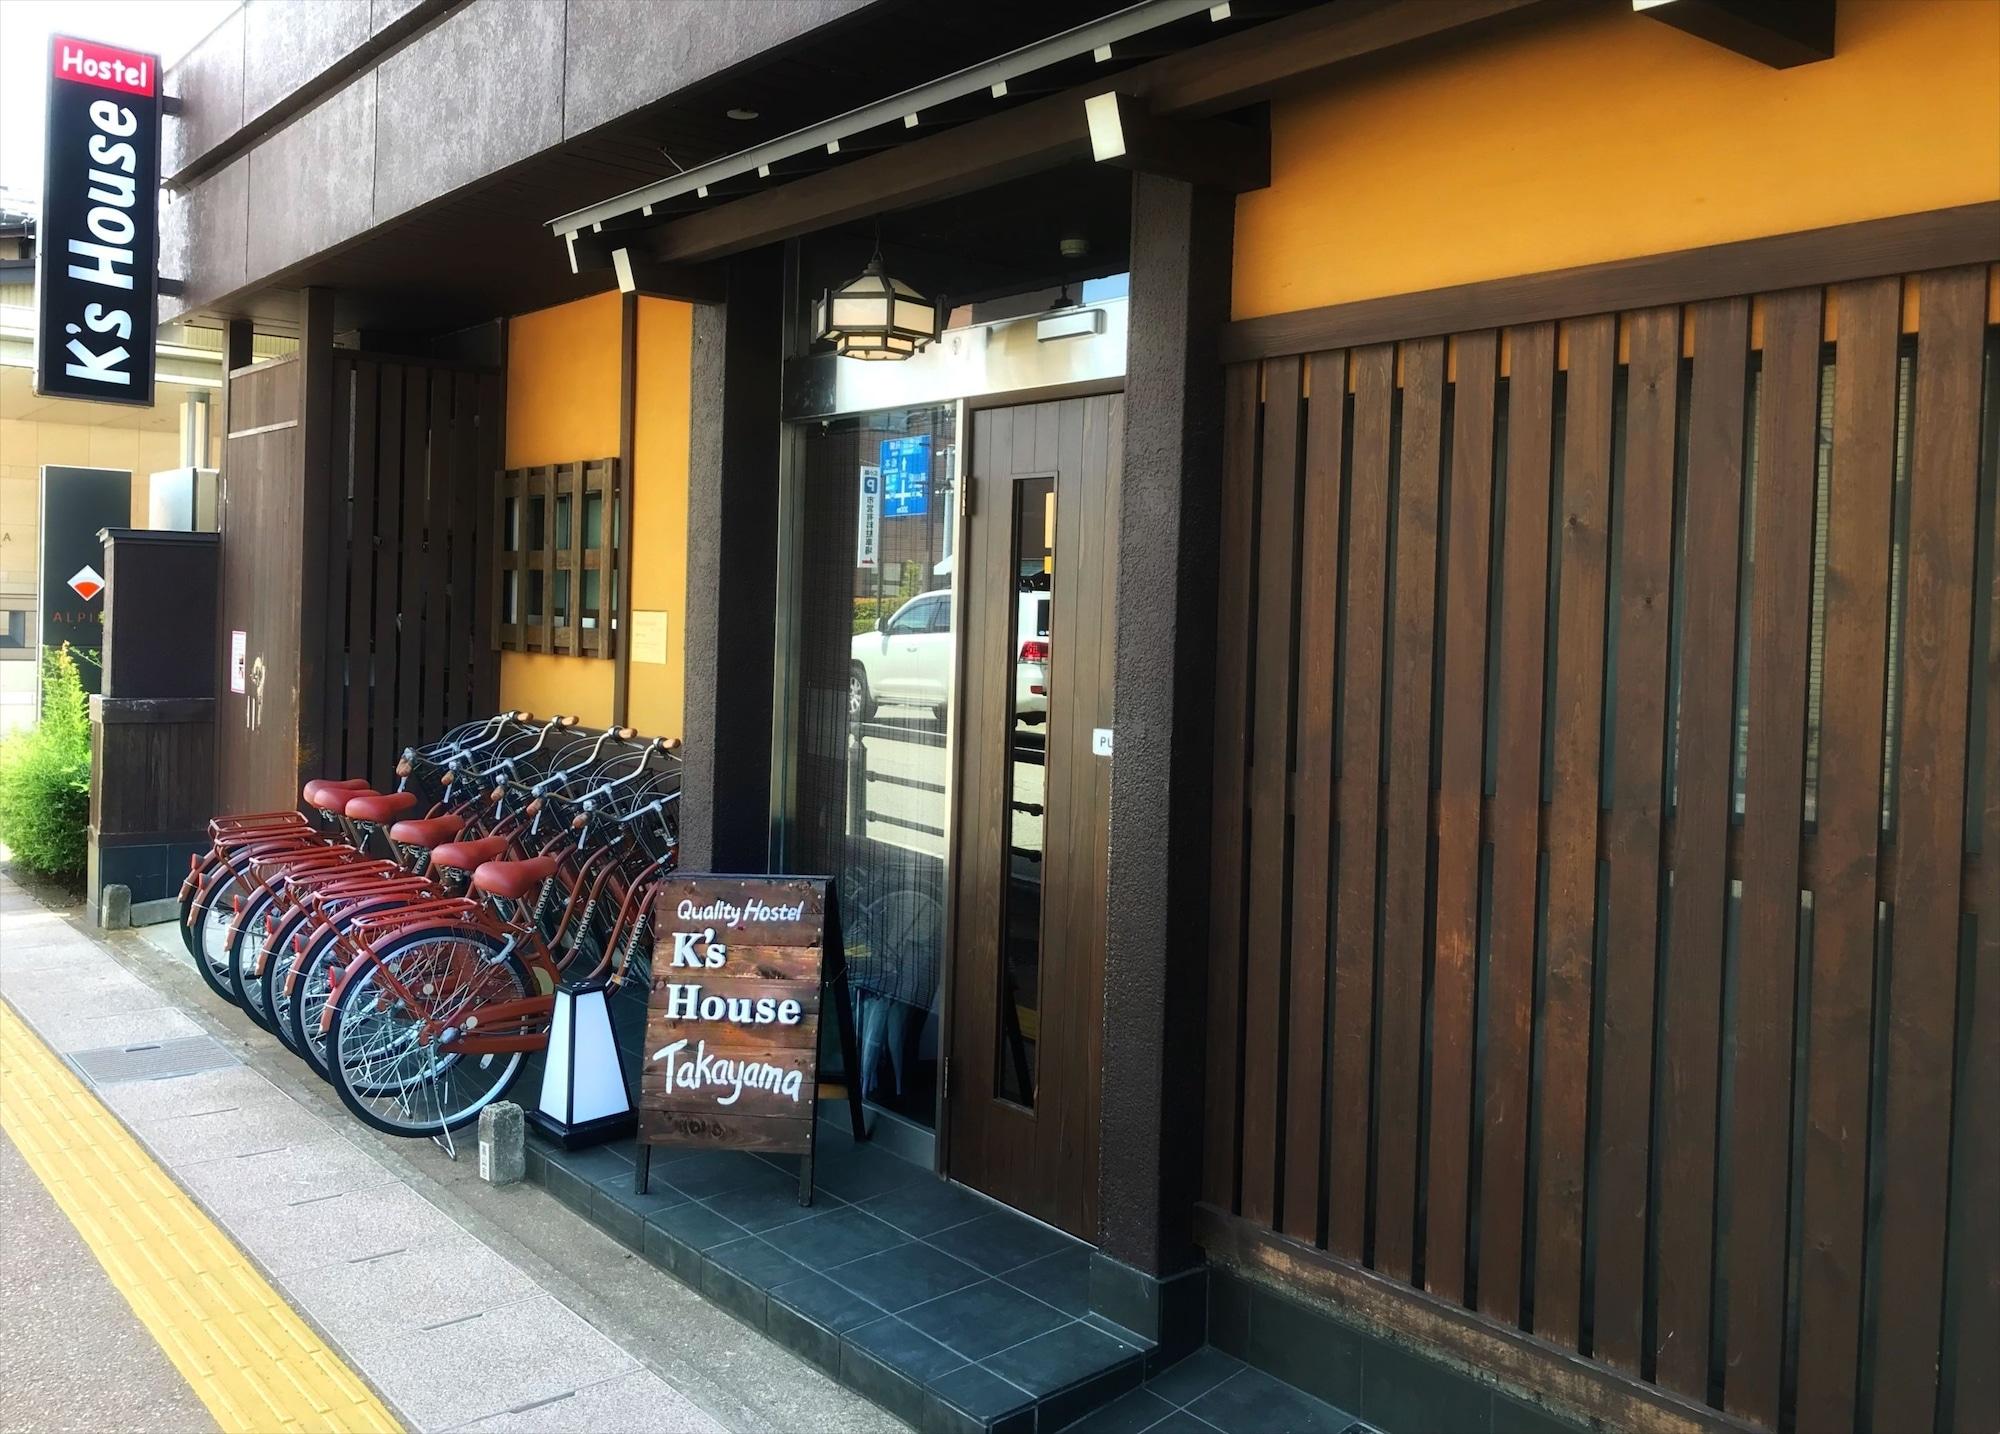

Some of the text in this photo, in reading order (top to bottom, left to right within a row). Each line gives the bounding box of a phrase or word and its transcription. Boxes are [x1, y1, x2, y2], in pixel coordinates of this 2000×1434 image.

[61, 46, 147, 88] Hostel
[65, 99, 138, 386] K's House
[52, 610, 104, 624] ALPI
[533, 877, 554, 921] EROKERO
[676, 898, 805, 928] Quality Hostel
[572, 899, 597, 950] KEROKERO
[669, 926, 727, 969] K's
[664, 982, 802, 1025] House
[652, 1038, 804, 1105] Takayama
